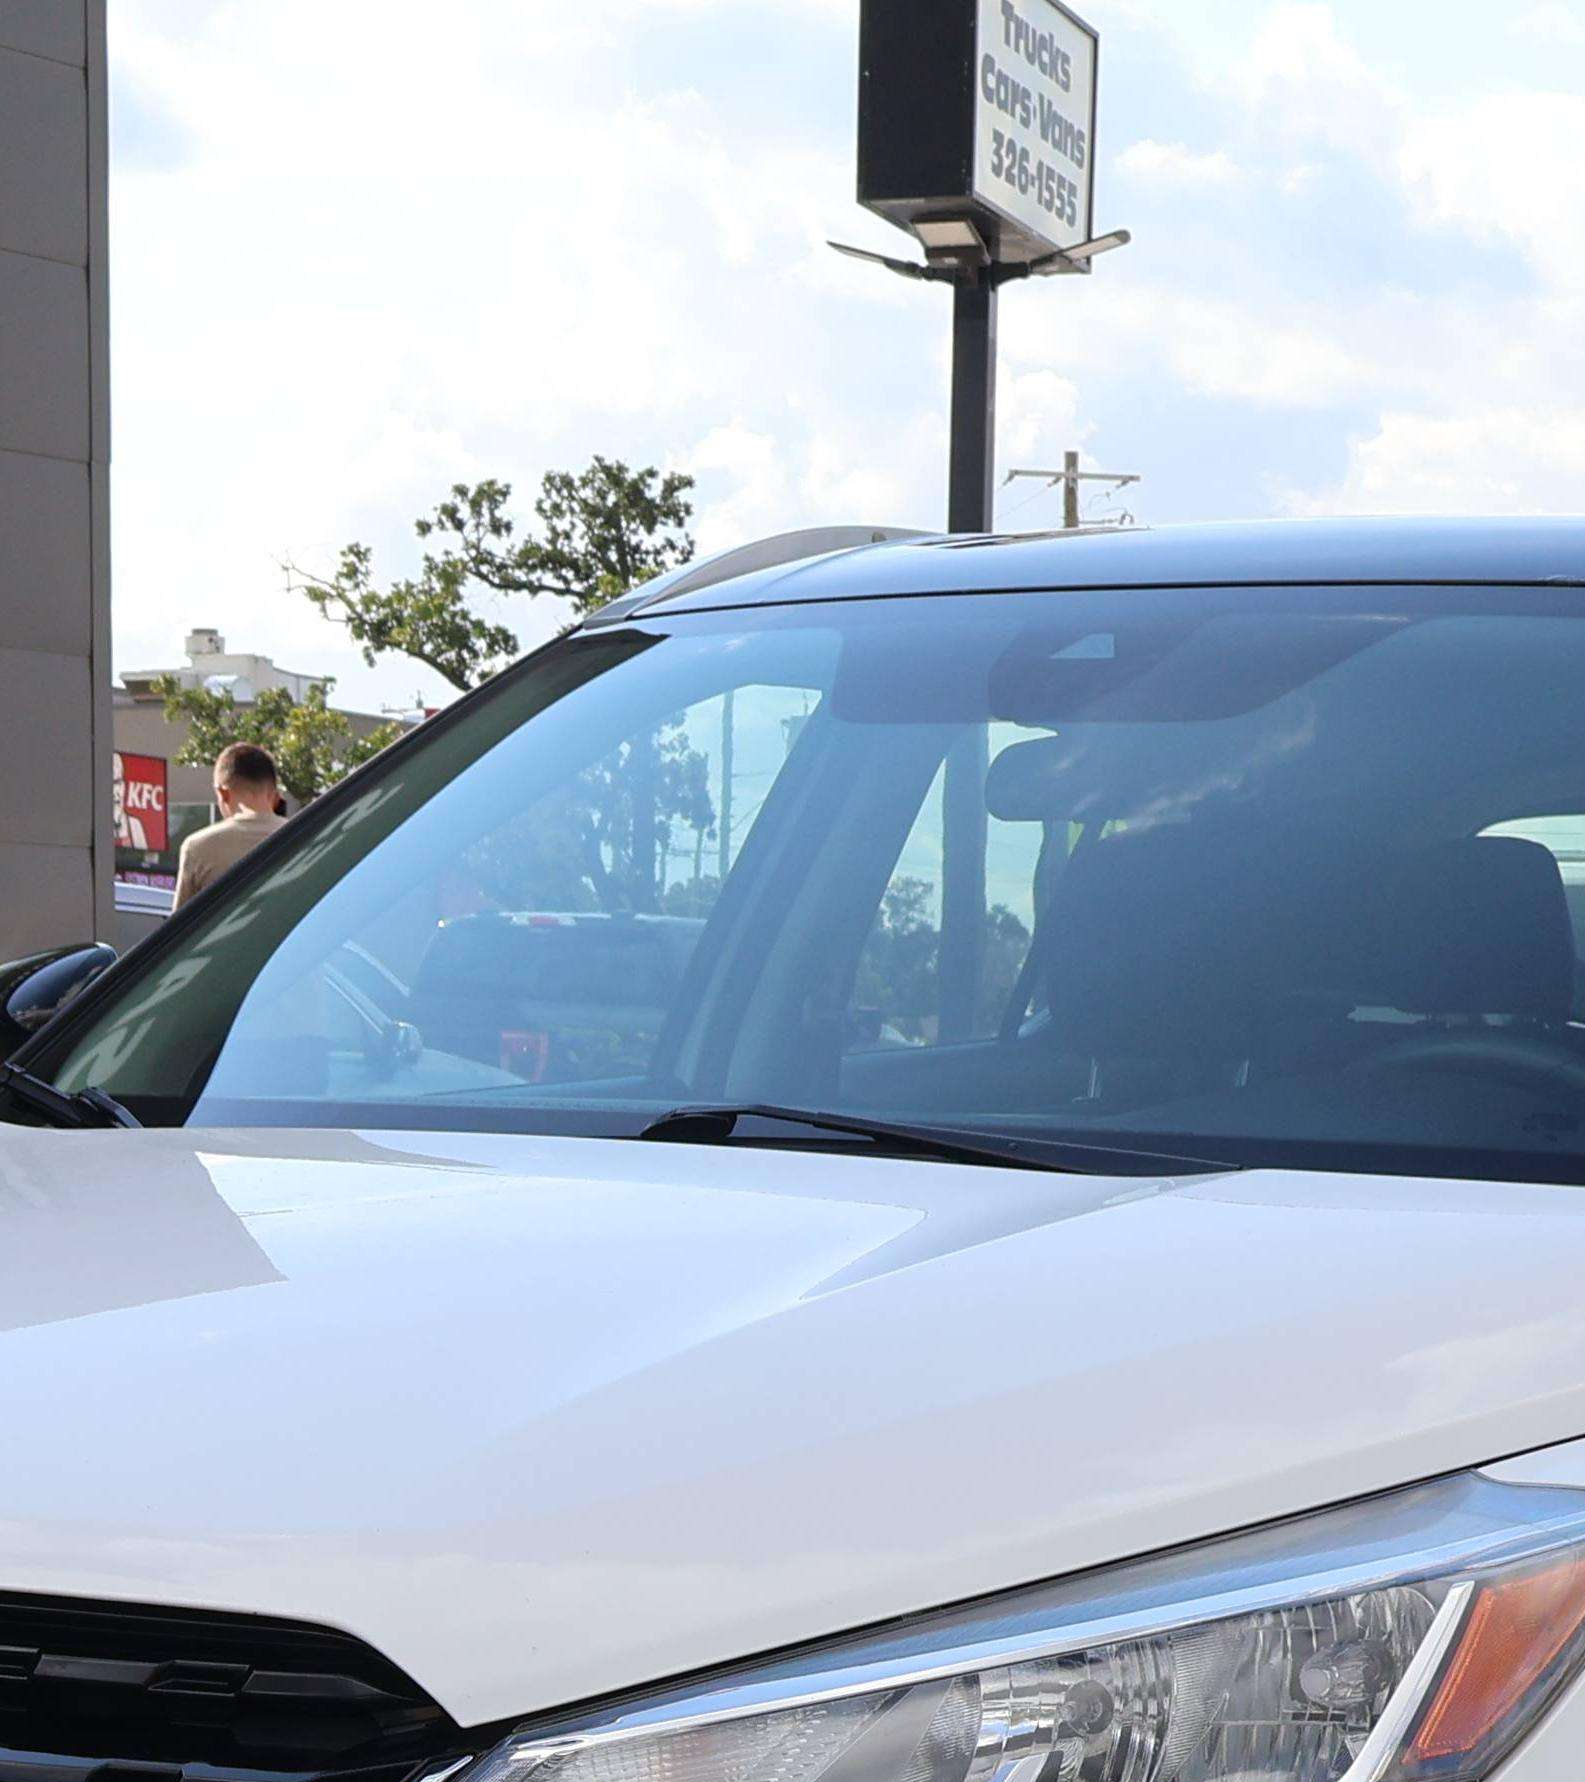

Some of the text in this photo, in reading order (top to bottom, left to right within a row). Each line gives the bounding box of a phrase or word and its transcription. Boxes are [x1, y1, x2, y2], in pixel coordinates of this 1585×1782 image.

[1000, 0, 1071, 93] Trucks
[991, 128, 1078, 228] 326-1555
[126, 781, 164, 811] KFC
